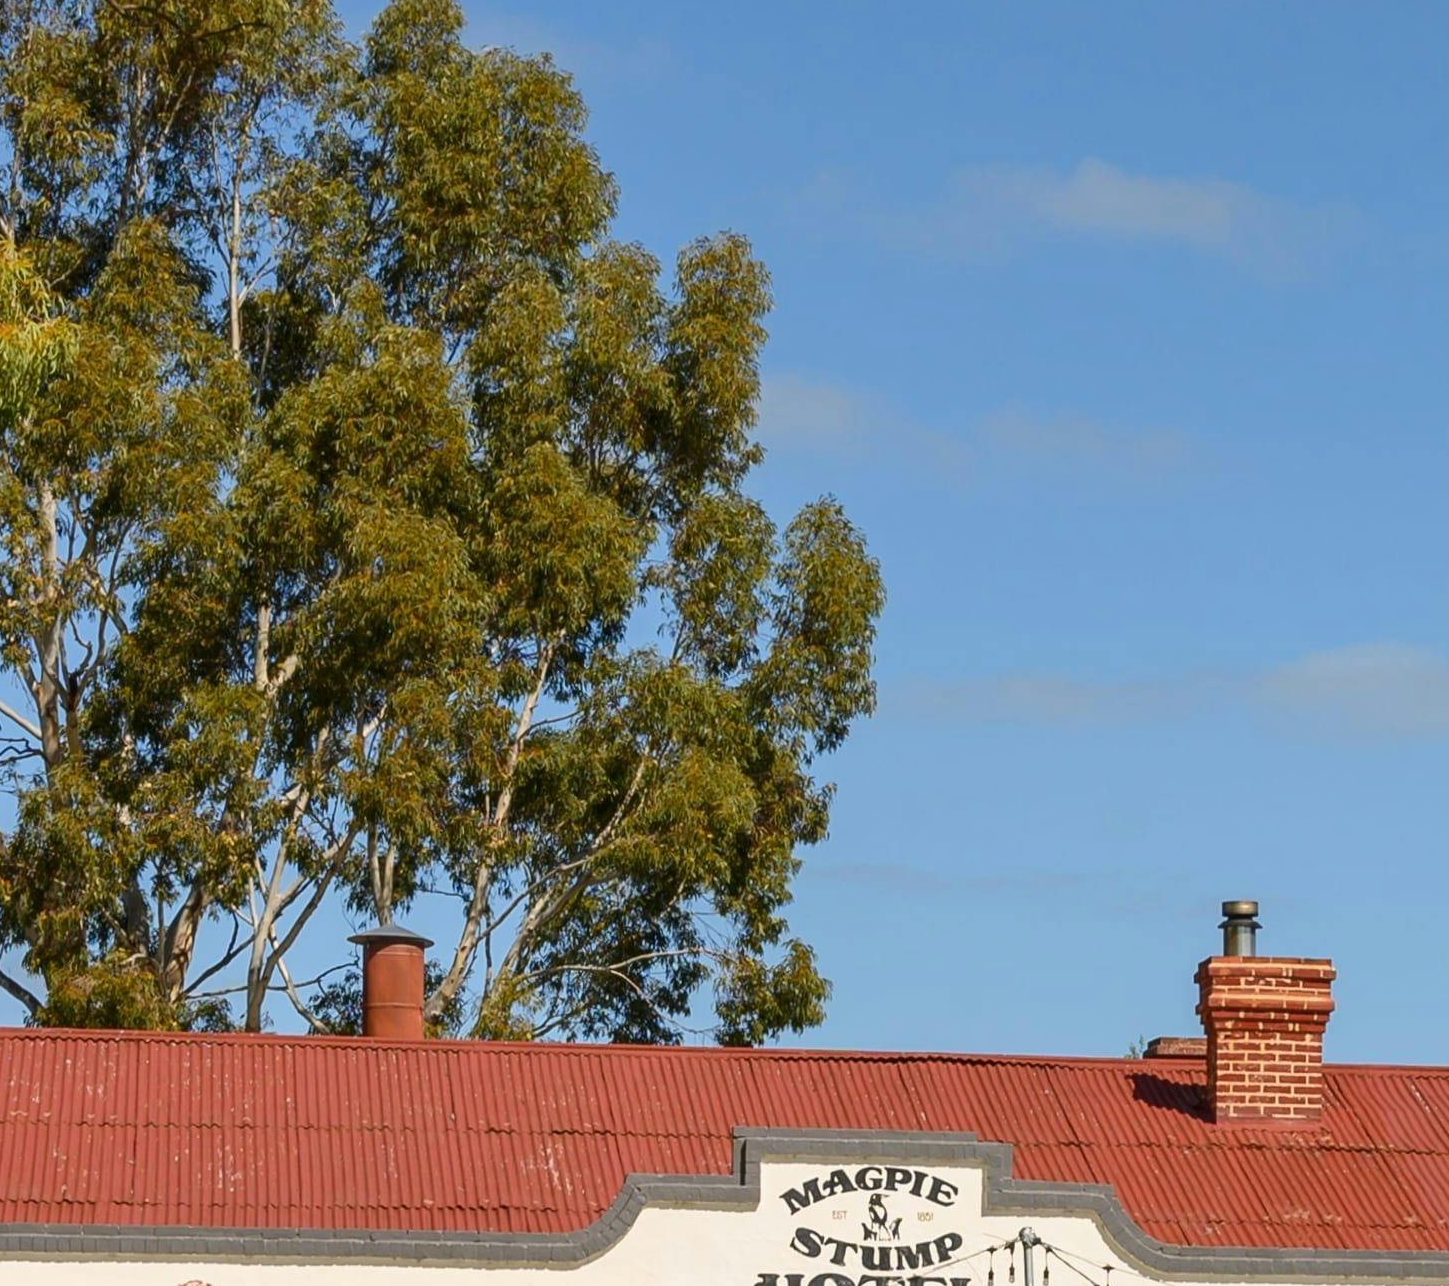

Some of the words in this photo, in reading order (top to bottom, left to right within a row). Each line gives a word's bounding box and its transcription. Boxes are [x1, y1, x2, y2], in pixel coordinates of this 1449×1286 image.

[779, 1166, 958, 1215] MAGPIE
[831, 1210, 847, 1220] EST
[789, 1227, 963, 1271] STUMP
